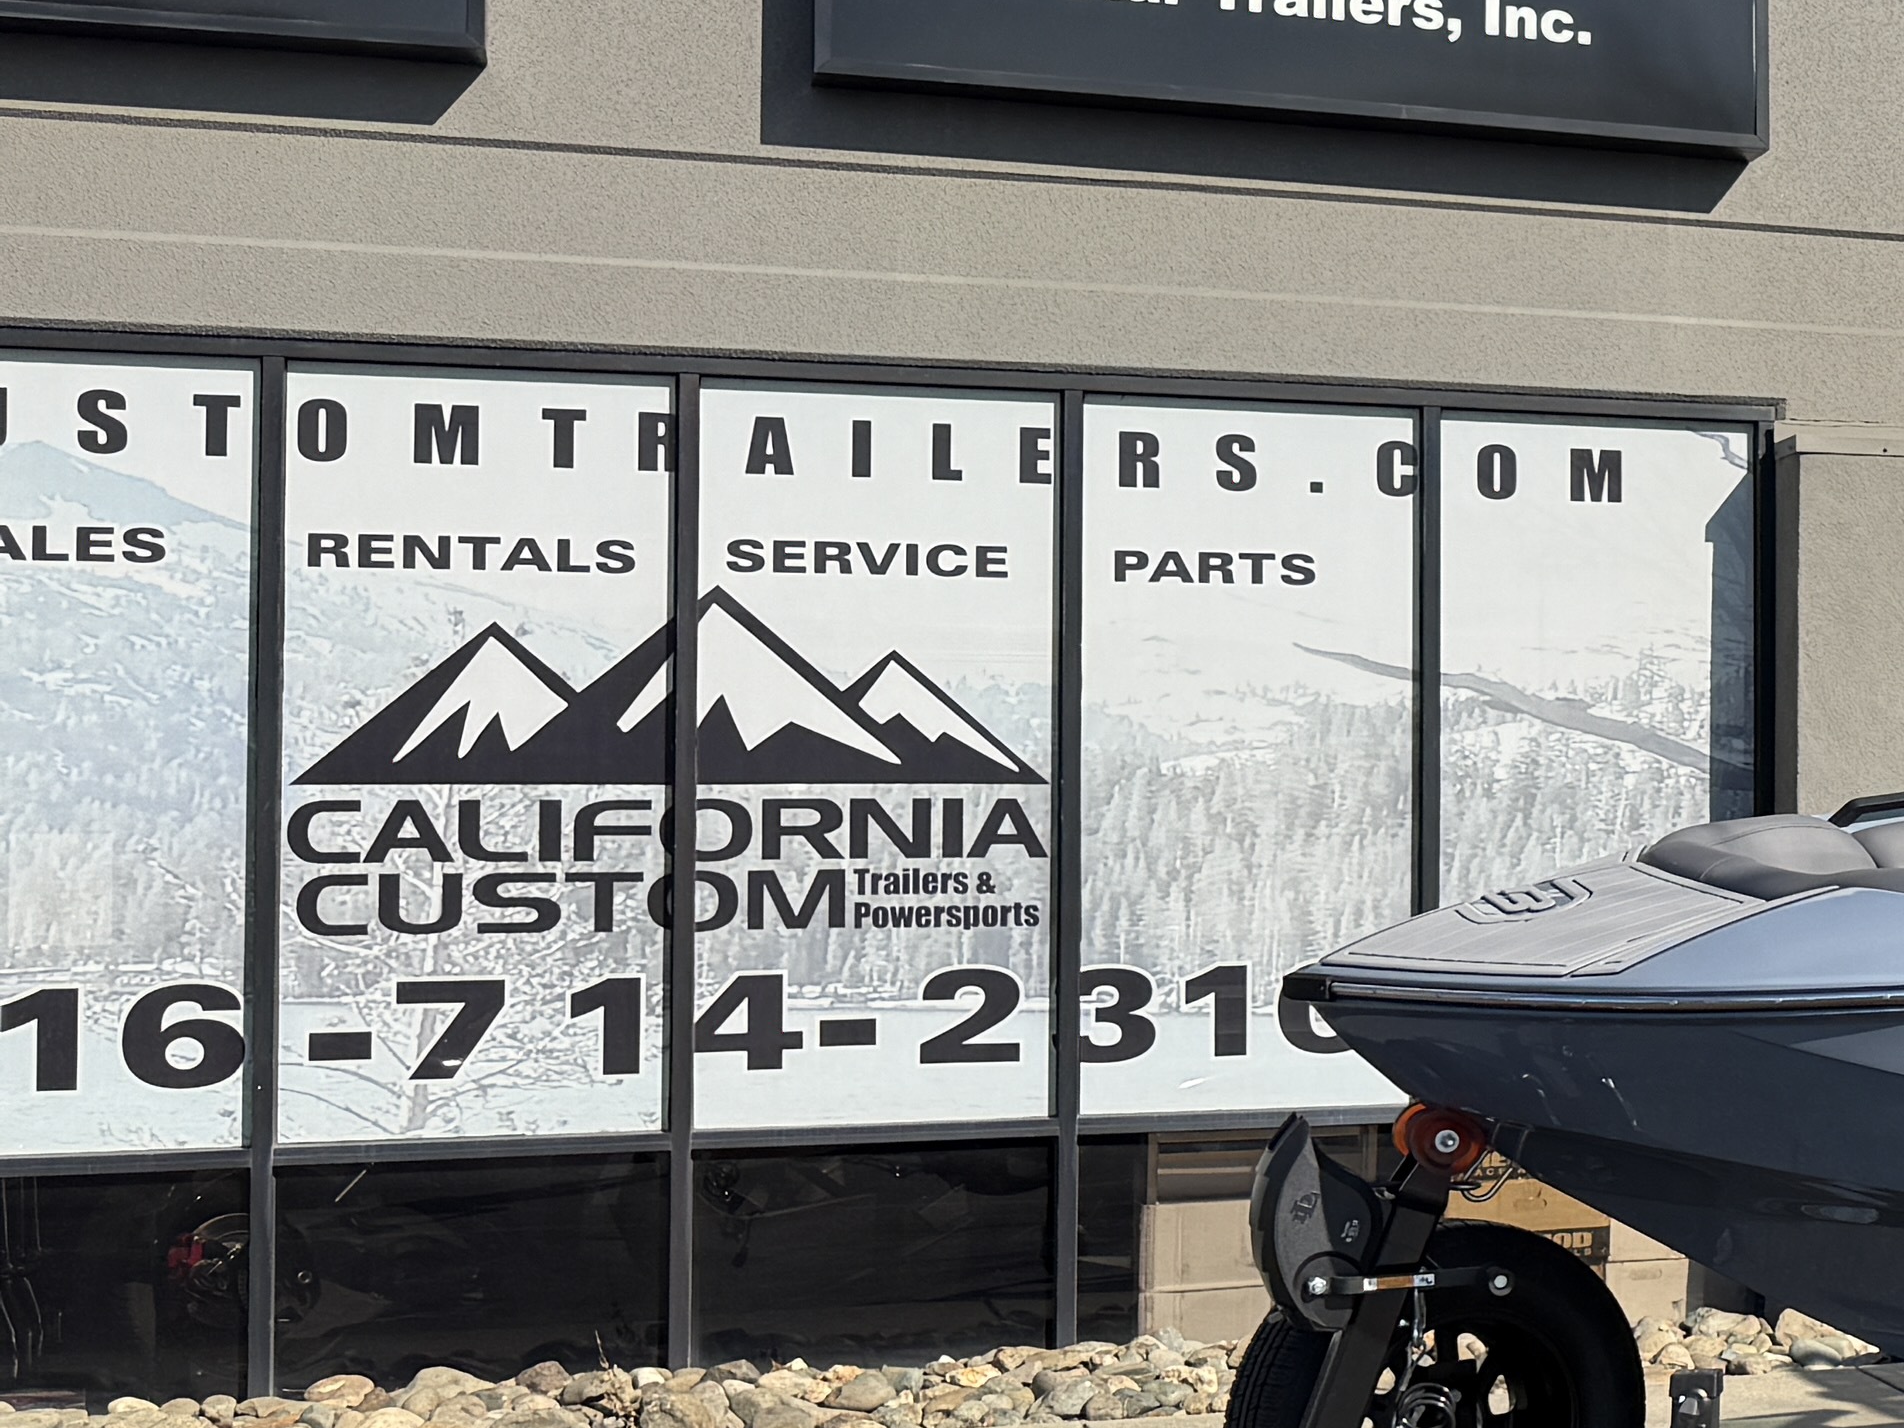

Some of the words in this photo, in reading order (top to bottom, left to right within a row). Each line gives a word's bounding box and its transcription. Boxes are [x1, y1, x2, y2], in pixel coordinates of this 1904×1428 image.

[306, 534, 637, 573] RENTALS
[725, 538, 1009, 579] SERVICE
[1113, 550, 1317, 586] PARTS
[286, 798, 1049, 864] CALIFORNIA
[853, 868, 970, 895] Trailers
[975, 871, 996, 894] &
[296, 869, 846, 937] CUSTOM
[854, 902, 1040, 930] Powersports
